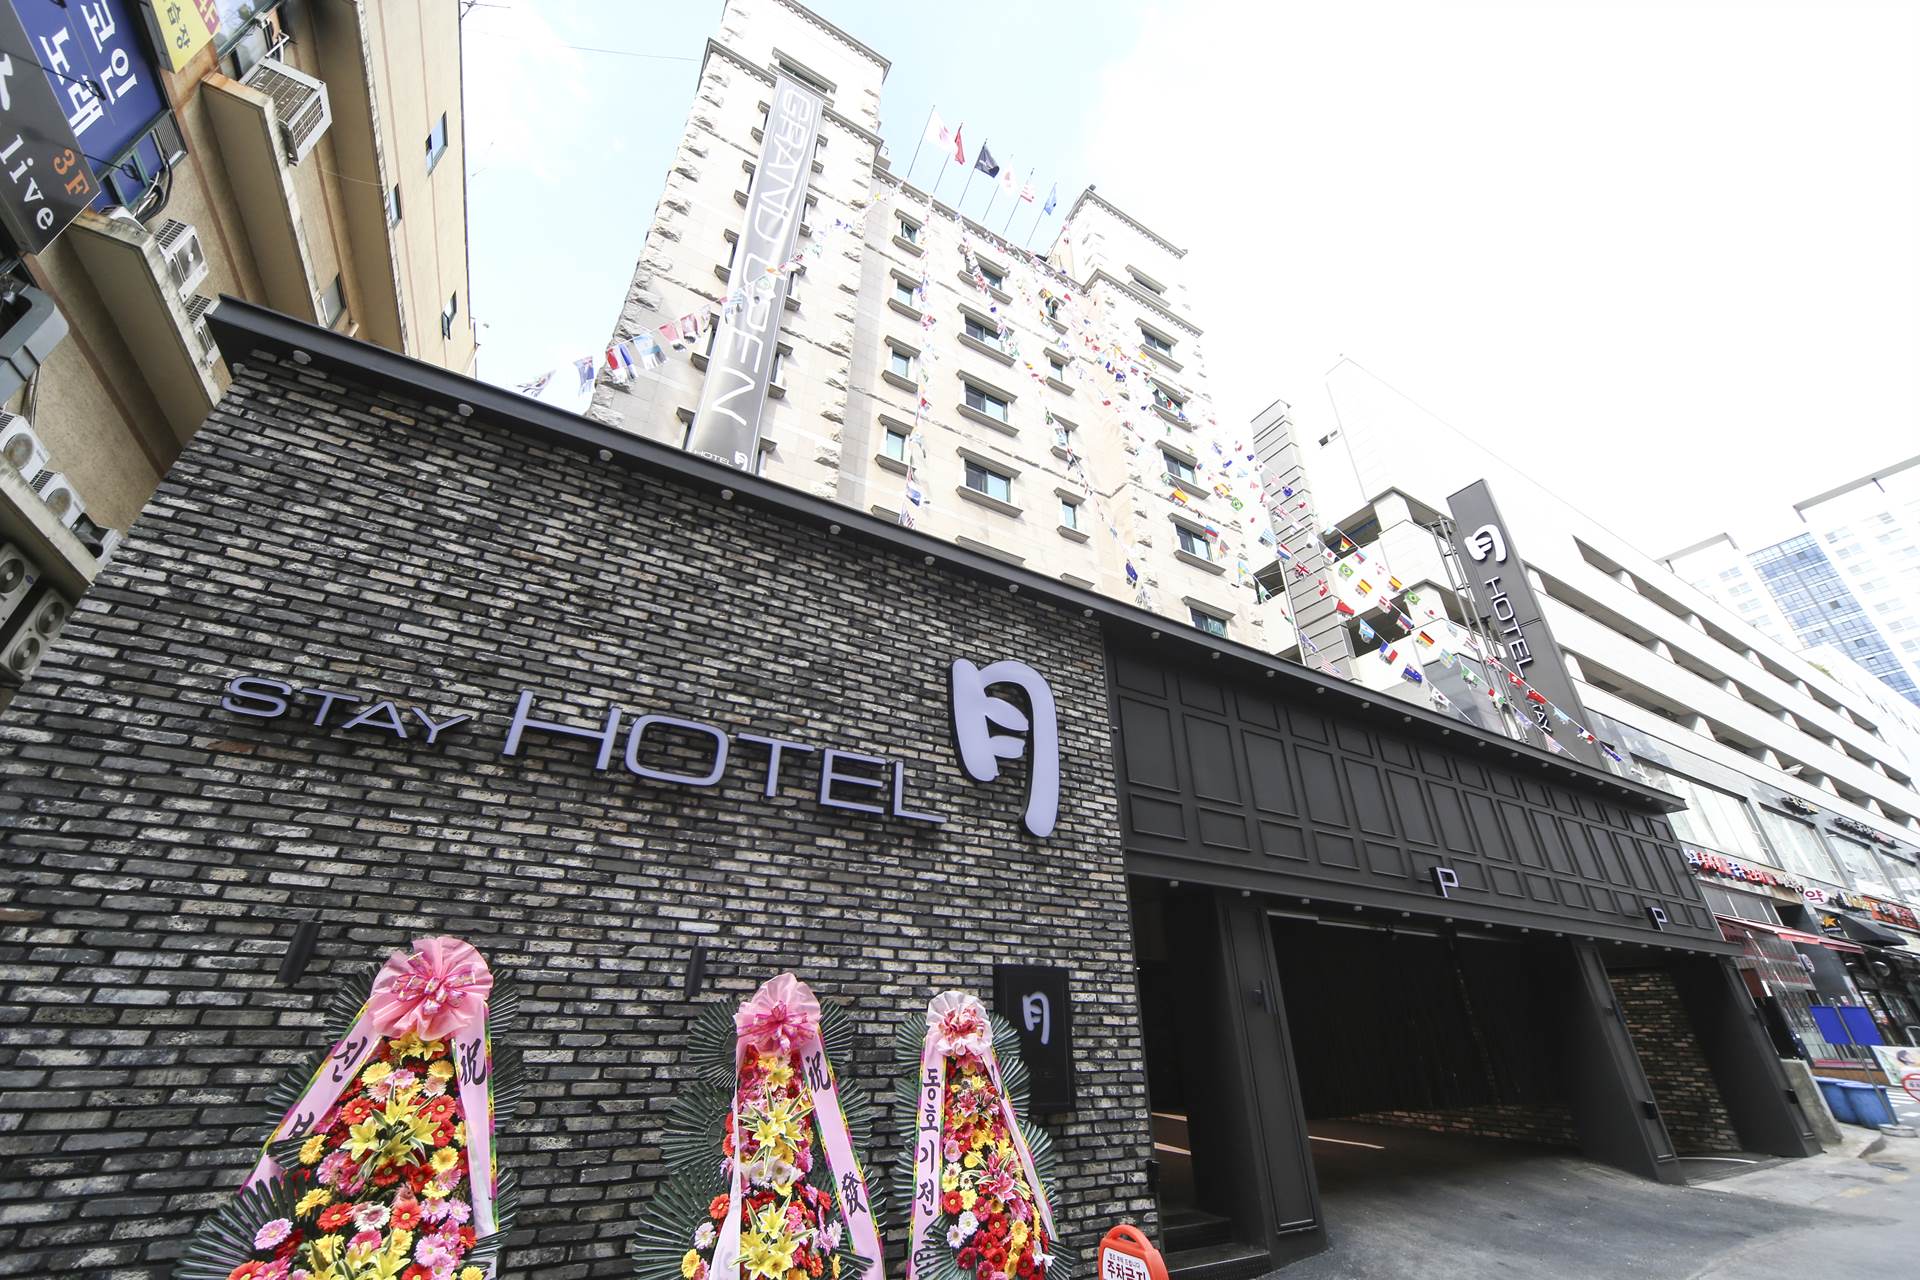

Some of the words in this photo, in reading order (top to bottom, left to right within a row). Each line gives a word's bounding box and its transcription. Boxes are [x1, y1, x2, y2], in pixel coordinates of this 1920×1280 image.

[39, 27, 104, 138] 노래
[81, 1, 138, 105] 코인
[0, 133, 54, 230] live
[52, 148, 90, 196] 3F
[754, 88, 812, 243] GRAND
[1484, 576, 1534, 679] HOTEL
[221, 675, 472, 744] STAY
[500, 688, 947, 824] HOTEL
[1436, 866, 1459, 899] P
[1651, 907, 1669, 932] P
